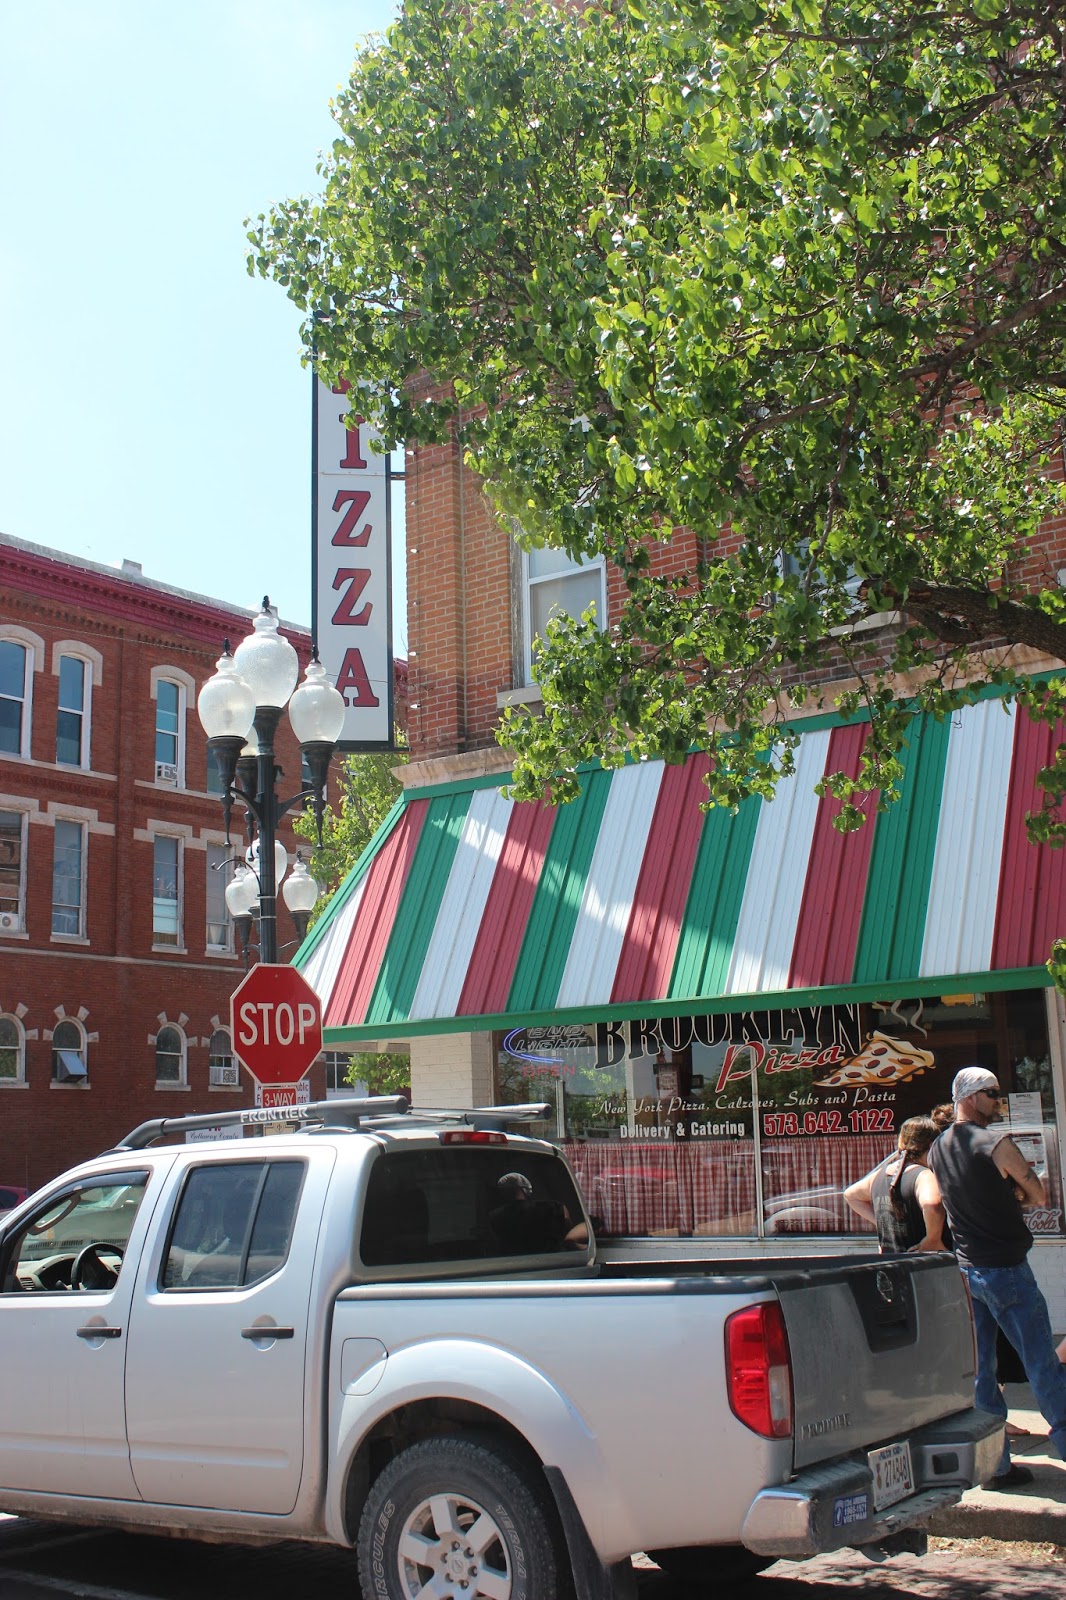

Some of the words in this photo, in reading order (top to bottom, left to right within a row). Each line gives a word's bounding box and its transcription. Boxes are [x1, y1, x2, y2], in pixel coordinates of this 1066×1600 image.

[331, 367, 380, 707] IZZA
[239, 1002, 316, 1046] STOP
[529, 1024, 585, 1039] BUD
[514, 1037, 587, 1053] LIGHT
[522, 1064, 576, 1078] OPEN
[715, 1041, 845, 1093] Pizza
[264, 1092, 295, 1107] 3-WAY
[592, 1100, 627, 1117] New
[627, 1098, 663, 1116] York
[668, 1096, 710, 1115] Pizza,
[784, 1090, 820, 1107] Subs
[825, 1091, 848, 1105] and
[853, 1087, 896, 1107] Pasta
[240, 1106, 309, 1123] FRONTIER
[764, 1108, 895, 1136] 573.642.1122
[620, 1123, 671, 1139] Delivery
[676, 1123, 686, 1137] &
[691, 1121, 745, 1136] Catering
[495, 1504, 527, 1579] TERRA
